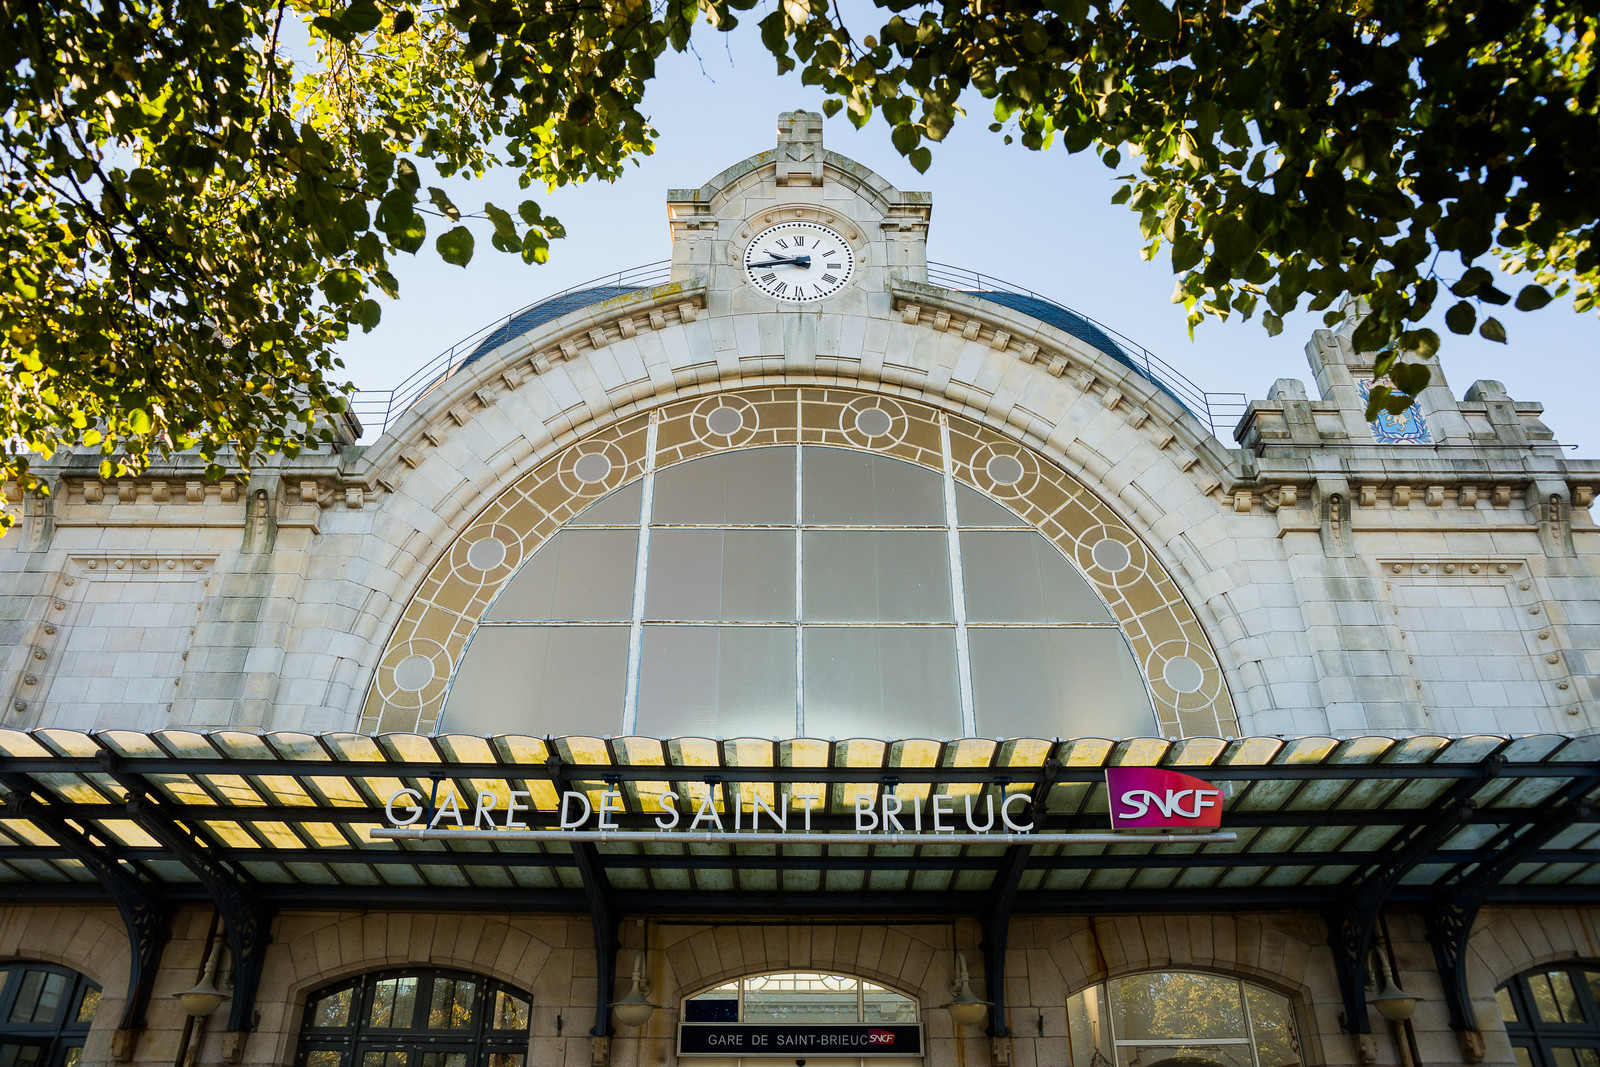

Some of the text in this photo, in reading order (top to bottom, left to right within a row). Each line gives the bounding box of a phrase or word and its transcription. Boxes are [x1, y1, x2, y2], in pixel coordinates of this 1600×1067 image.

[793, 235, 805, 246] XII
[822, 249, 836, 258] II
[1118, 788, 1219, 819] SNCF
[385, 788, 1034, 832] GARE DE SAINT BRIEUC
[708, 1034, 868, 1046] GARE DE SAINT-BRIEUC
[869, 1034, 895, 1043] SNCF
